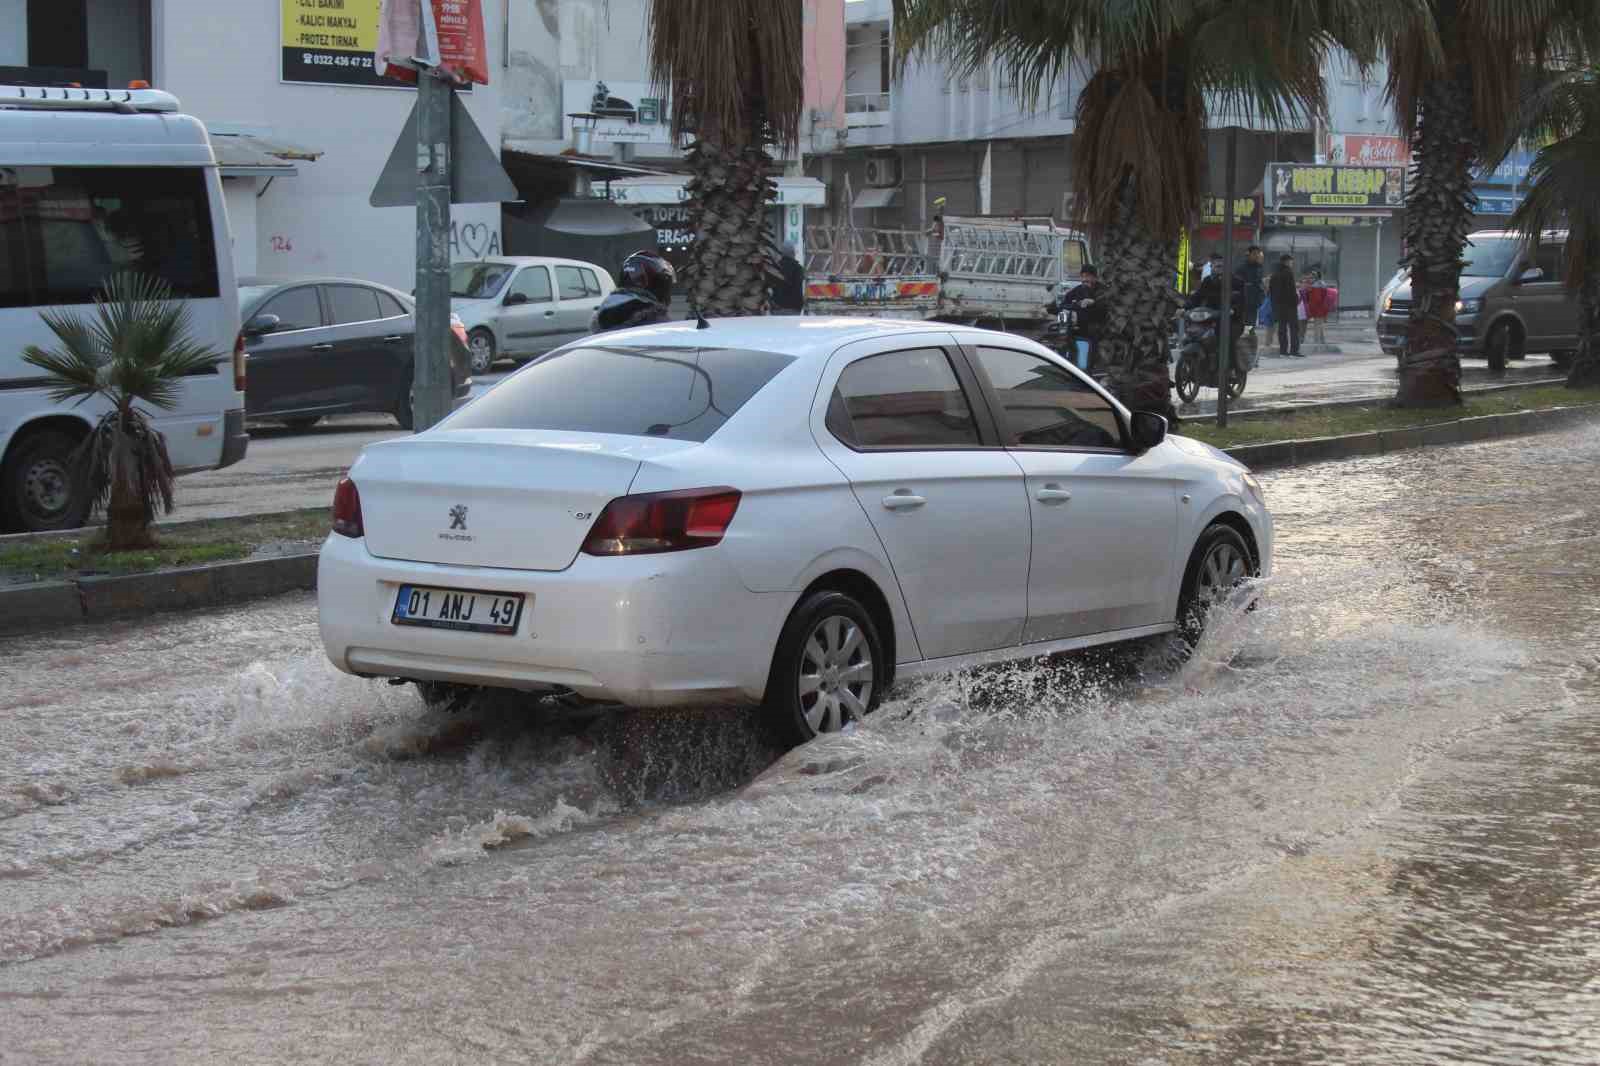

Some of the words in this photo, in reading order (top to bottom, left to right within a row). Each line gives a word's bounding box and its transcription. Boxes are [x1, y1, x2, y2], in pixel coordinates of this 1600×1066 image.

[327, 17, 357, 28] MAKYAJ
[300, 33, 329, 46] PROTEZ
[331, 35, 358, 47] TIRNAK
[313, 54, 333, 64] 0322
[351, 57, 360, 66] 47
[408, 591, 430, 617] 01
[440, 593, 475, 620] ANJ
[489, 597, 515, 625] 49
